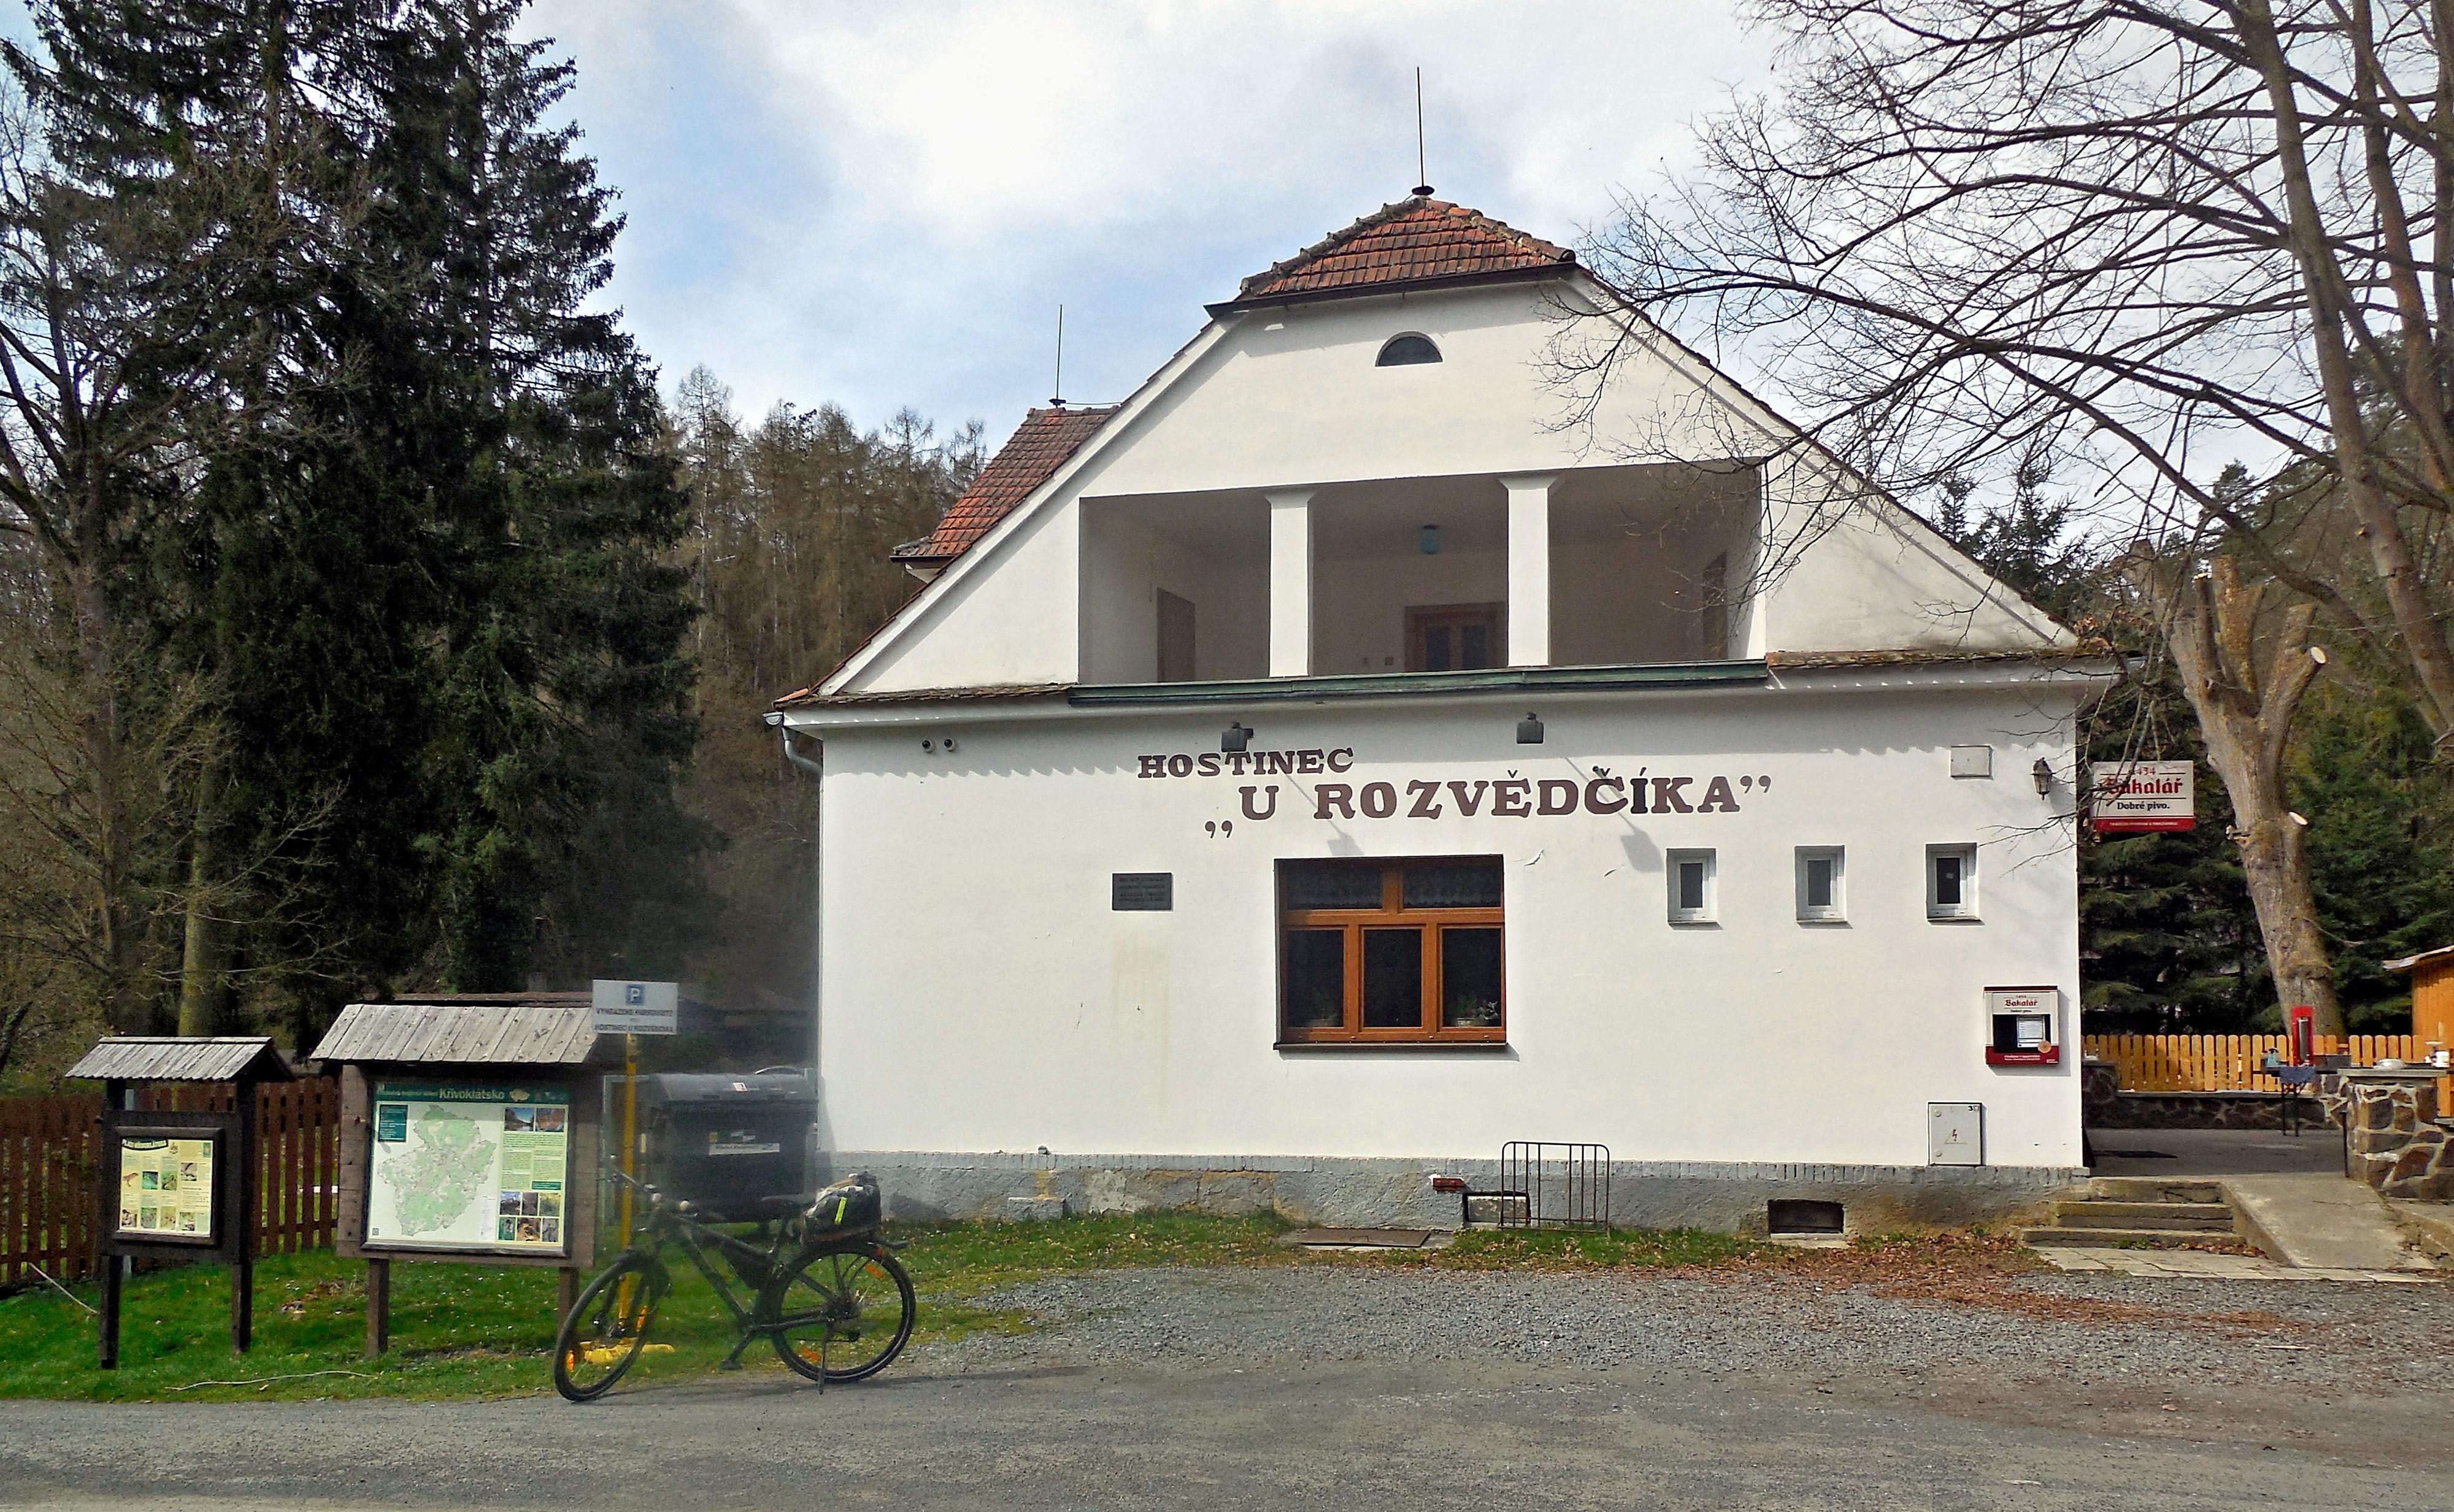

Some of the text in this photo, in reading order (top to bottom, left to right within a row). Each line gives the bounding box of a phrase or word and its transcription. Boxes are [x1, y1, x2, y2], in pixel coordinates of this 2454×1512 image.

[1138, 747, 1354, 778] HOSTINEC
[2117, 801, 2170, 811] Dobré pivo.
[631, 988, 640, 1002] P
